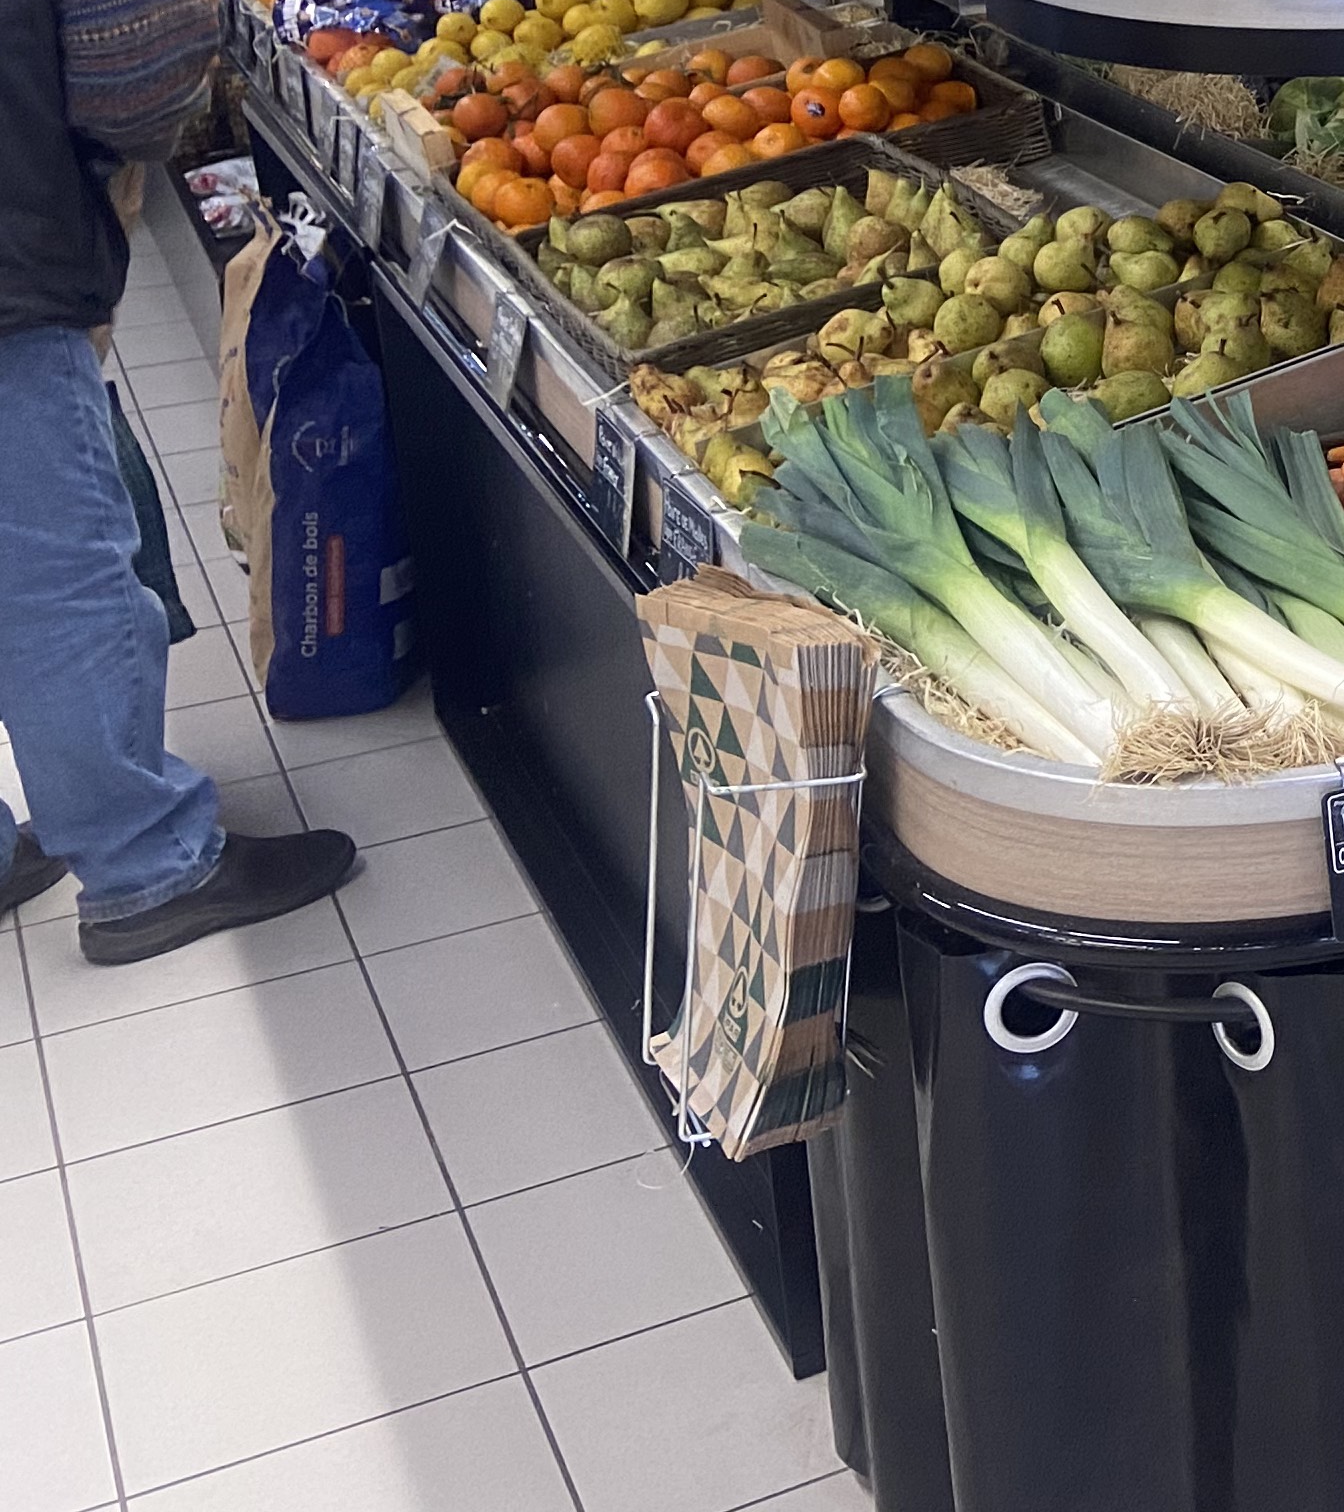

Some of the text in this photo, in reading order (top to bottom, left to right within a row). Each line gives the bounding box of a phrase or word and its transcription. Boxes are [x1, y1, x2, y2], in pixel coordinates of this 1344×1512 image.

[300, 510, 319, 658] Charbon de bois
